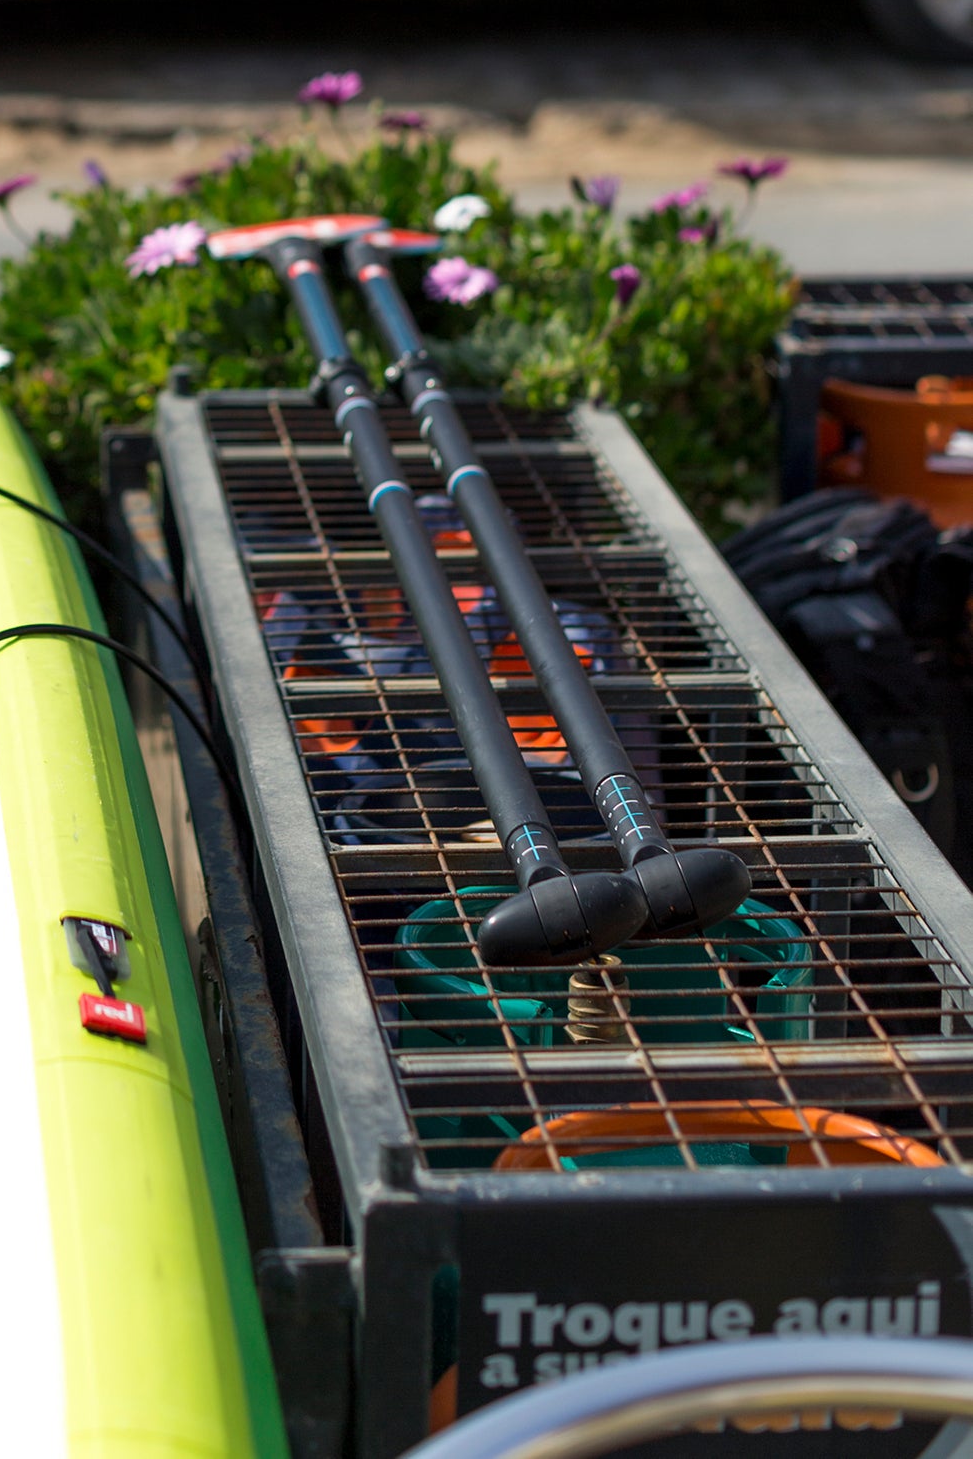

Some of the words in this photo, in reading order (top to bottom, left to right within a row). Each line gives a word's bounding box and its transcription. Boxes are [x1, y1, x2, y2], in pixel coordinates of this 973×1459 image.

[94, 1002, 134, 1023] red
[482, 1293, 754, 1355] Troque
[774, 1281, 941, 1338] aqui
[480, 1352, 519, 1388] a
